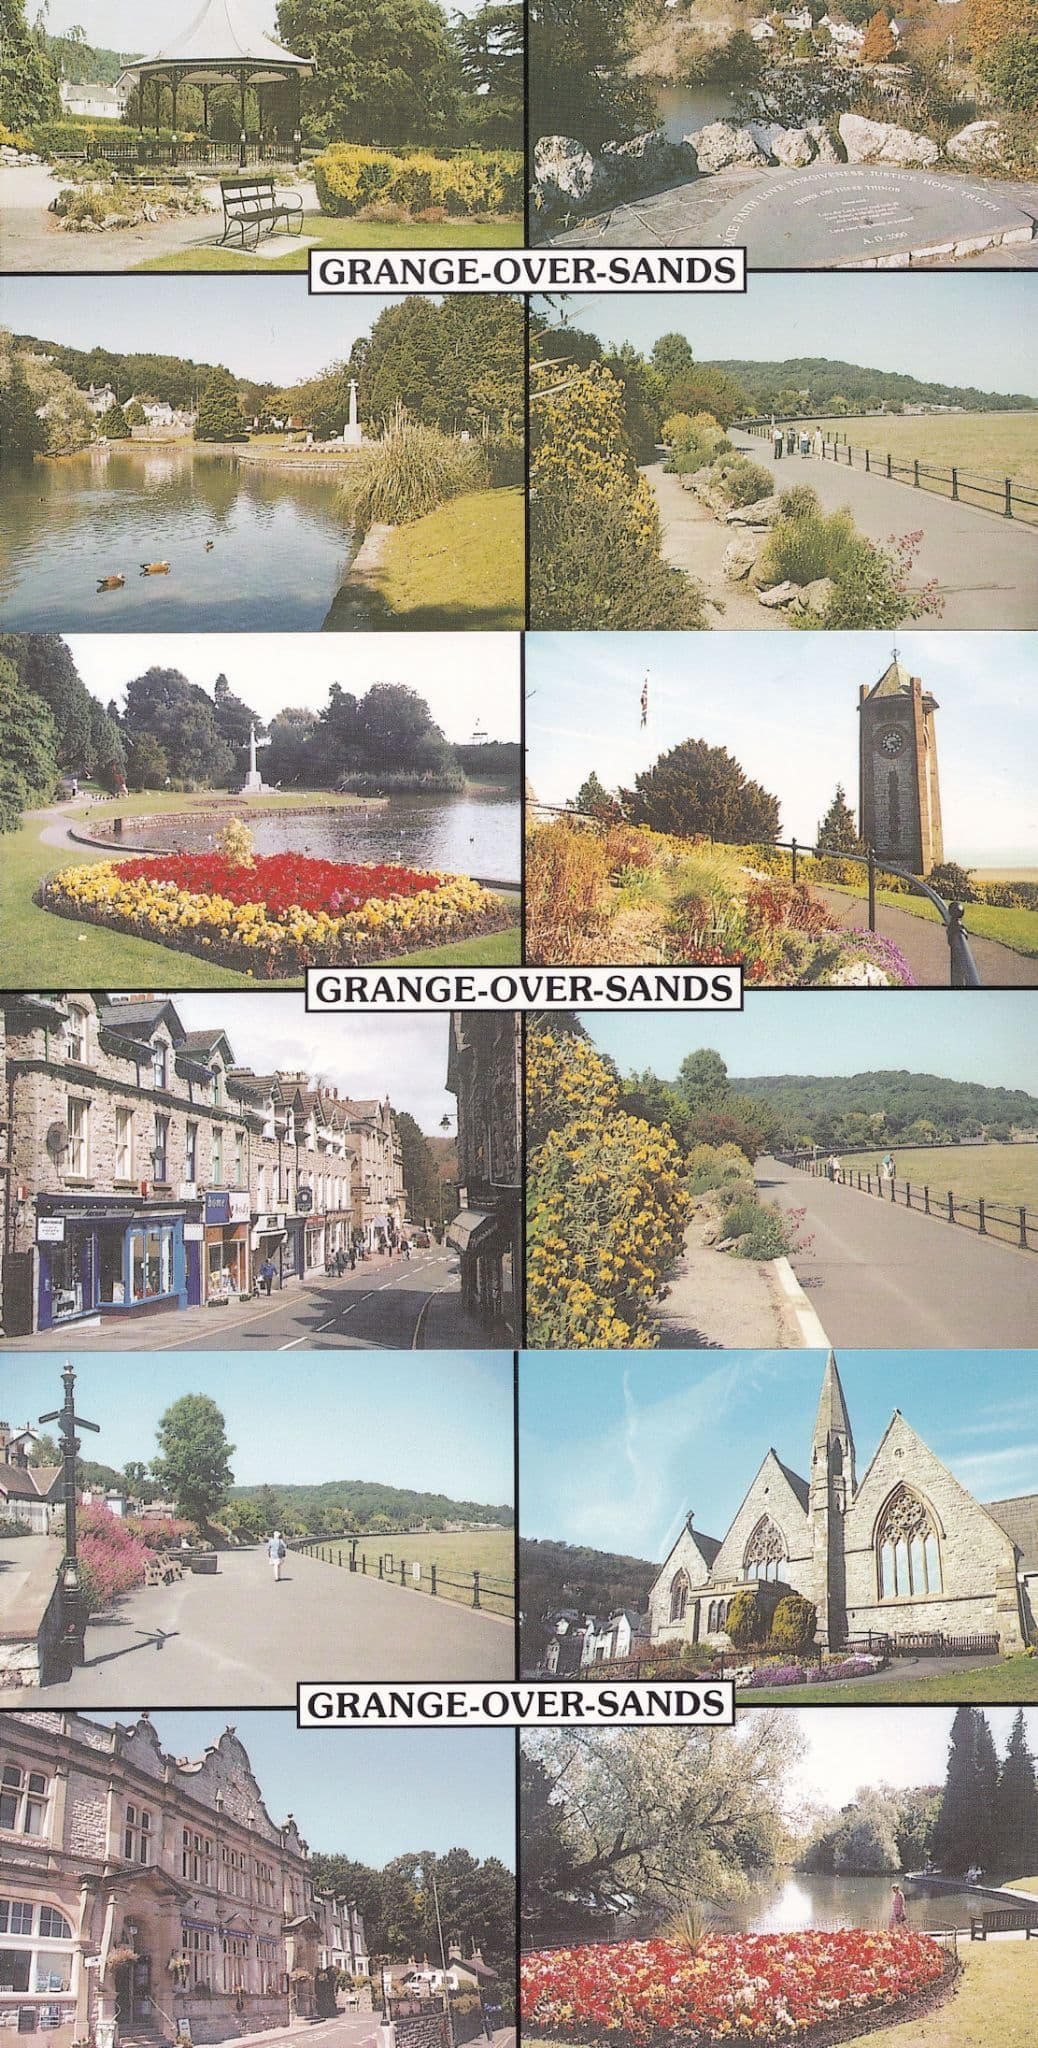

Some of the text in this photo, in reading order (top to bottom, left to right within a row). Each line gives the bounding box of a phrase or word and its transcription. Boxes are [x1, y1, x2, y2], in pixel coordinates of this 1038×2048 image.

[733, 200, 759, 223] FAITH
[756, 184, 786, 200] LOVE
[787, 170, 864, 187] FORGIVENESS
[869, 170, 918, 182] JUSTICE
[923, 179, 955, 192] HOPE
[960, 191, 1001, 212] TRUTH
